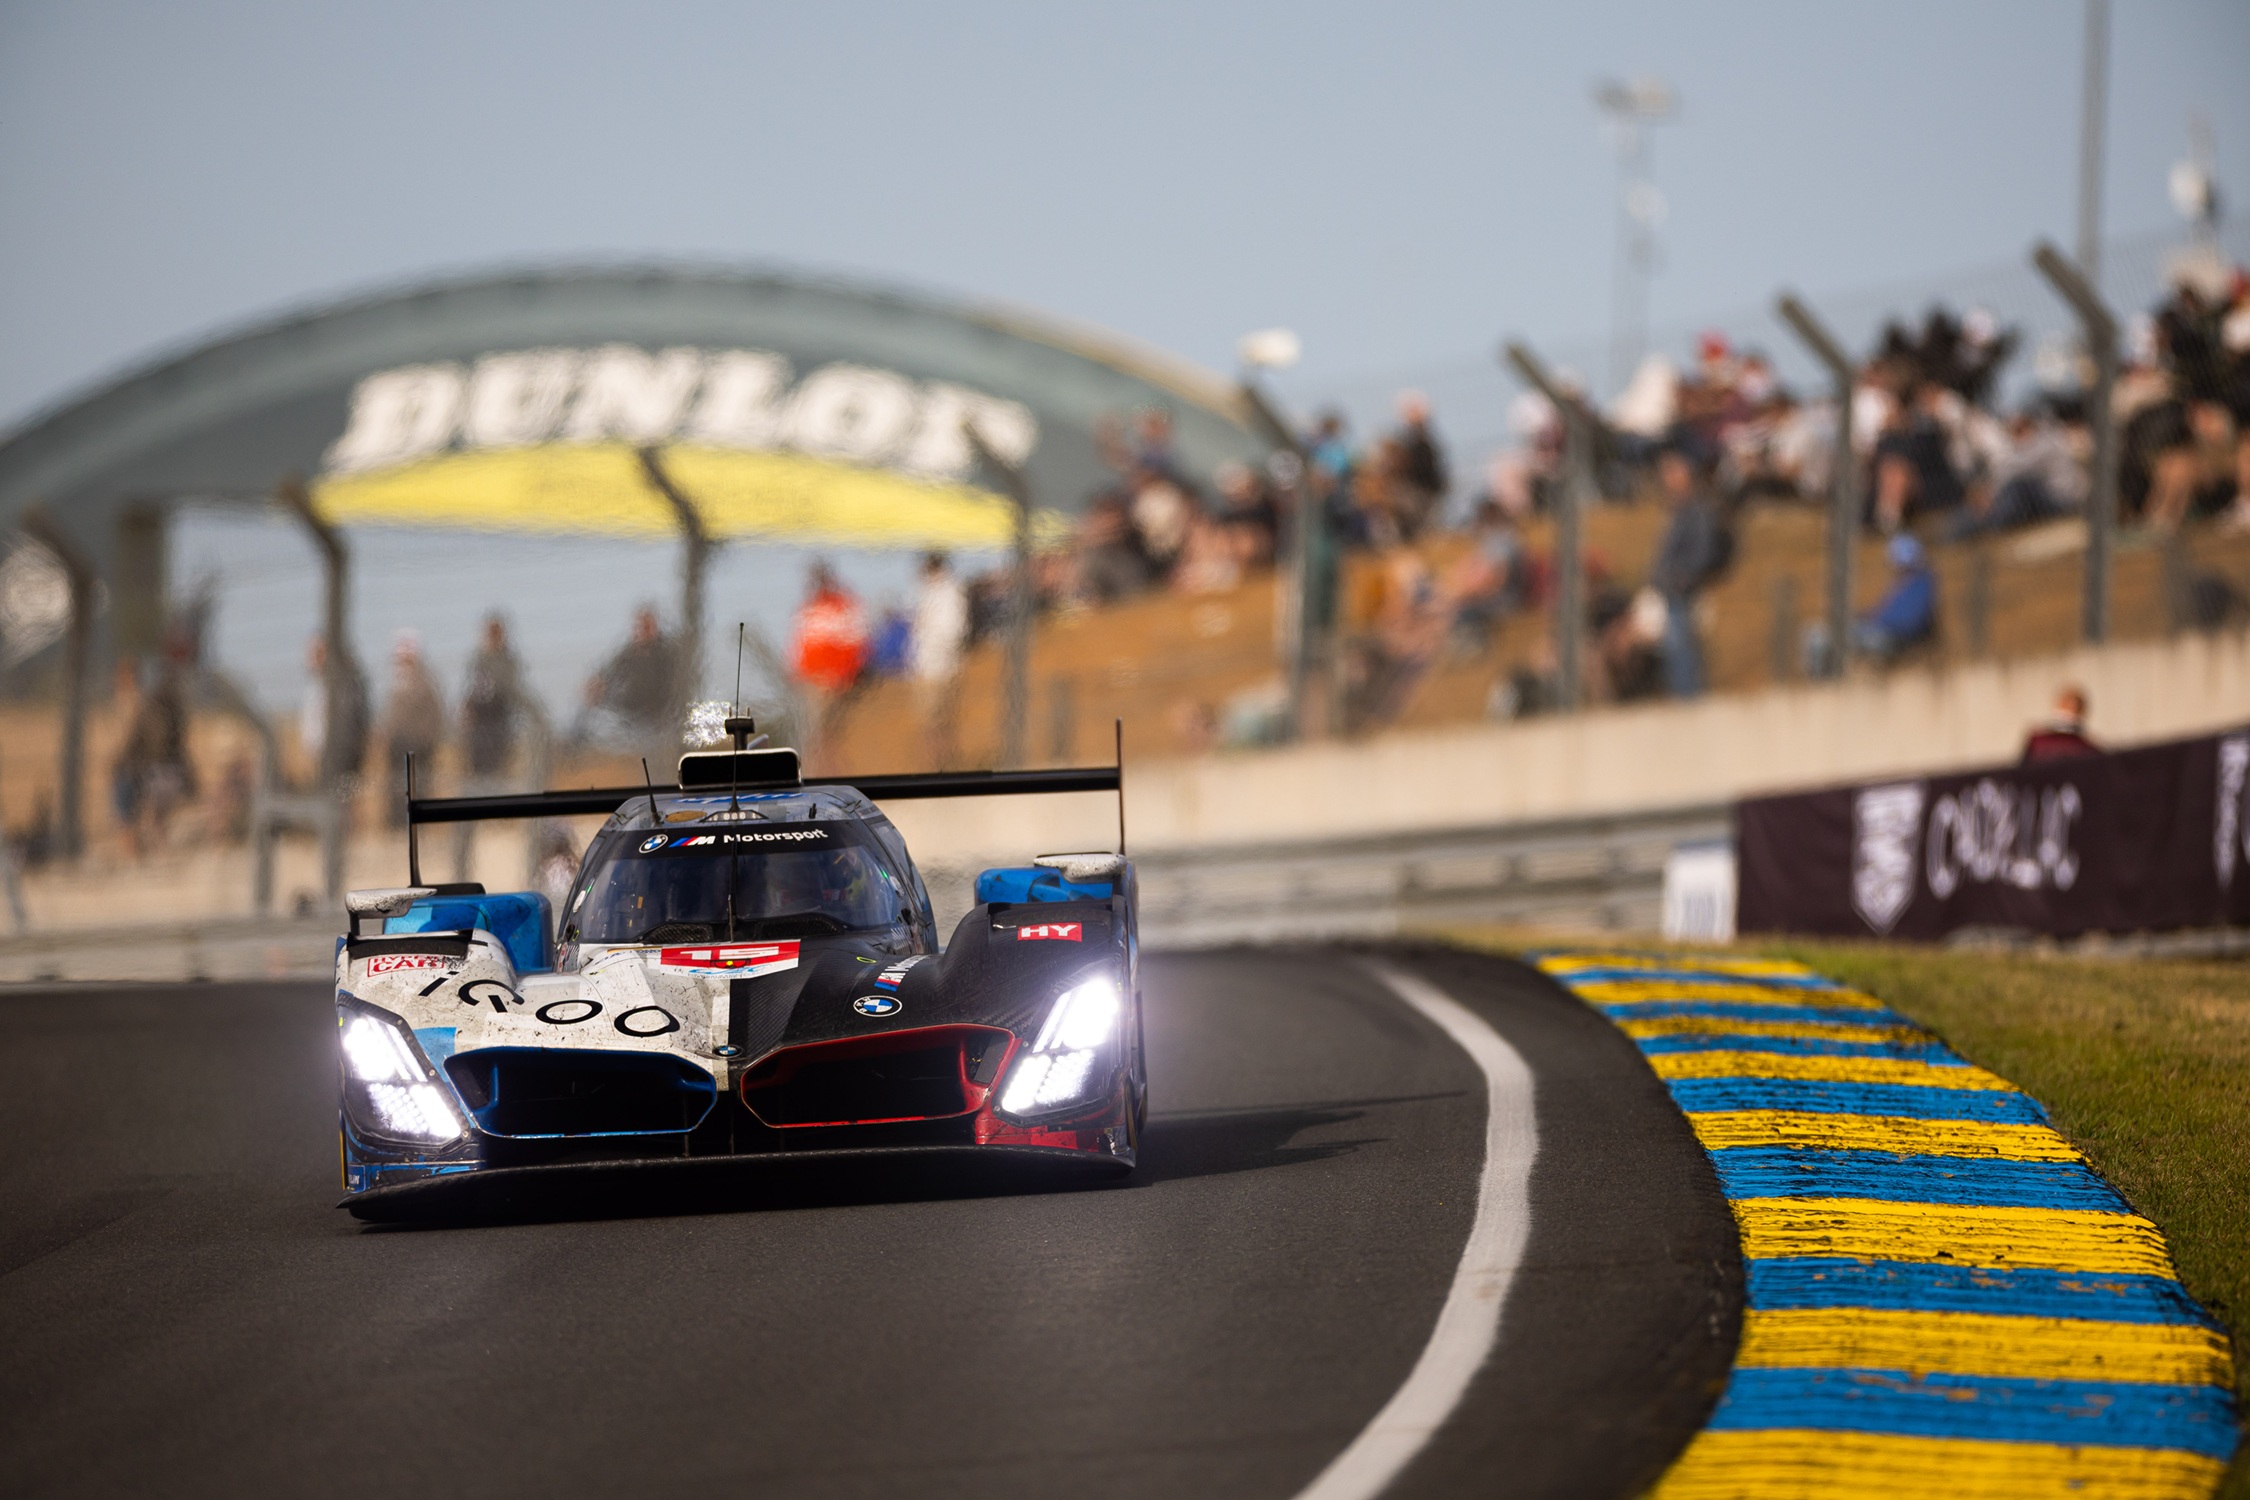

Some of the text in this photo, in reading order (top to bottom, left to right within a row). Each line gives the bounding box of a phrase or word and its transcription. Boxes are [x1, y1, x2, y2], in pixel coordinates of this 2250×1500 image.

[324, 344, 1038, 482] DUNLOP
[724, 828, 828, 843] Motorsport
[1021, 925, 1078, 938] HY
[680, 946, 779, 961] 15
[373, 959, 437, 973] CAR
